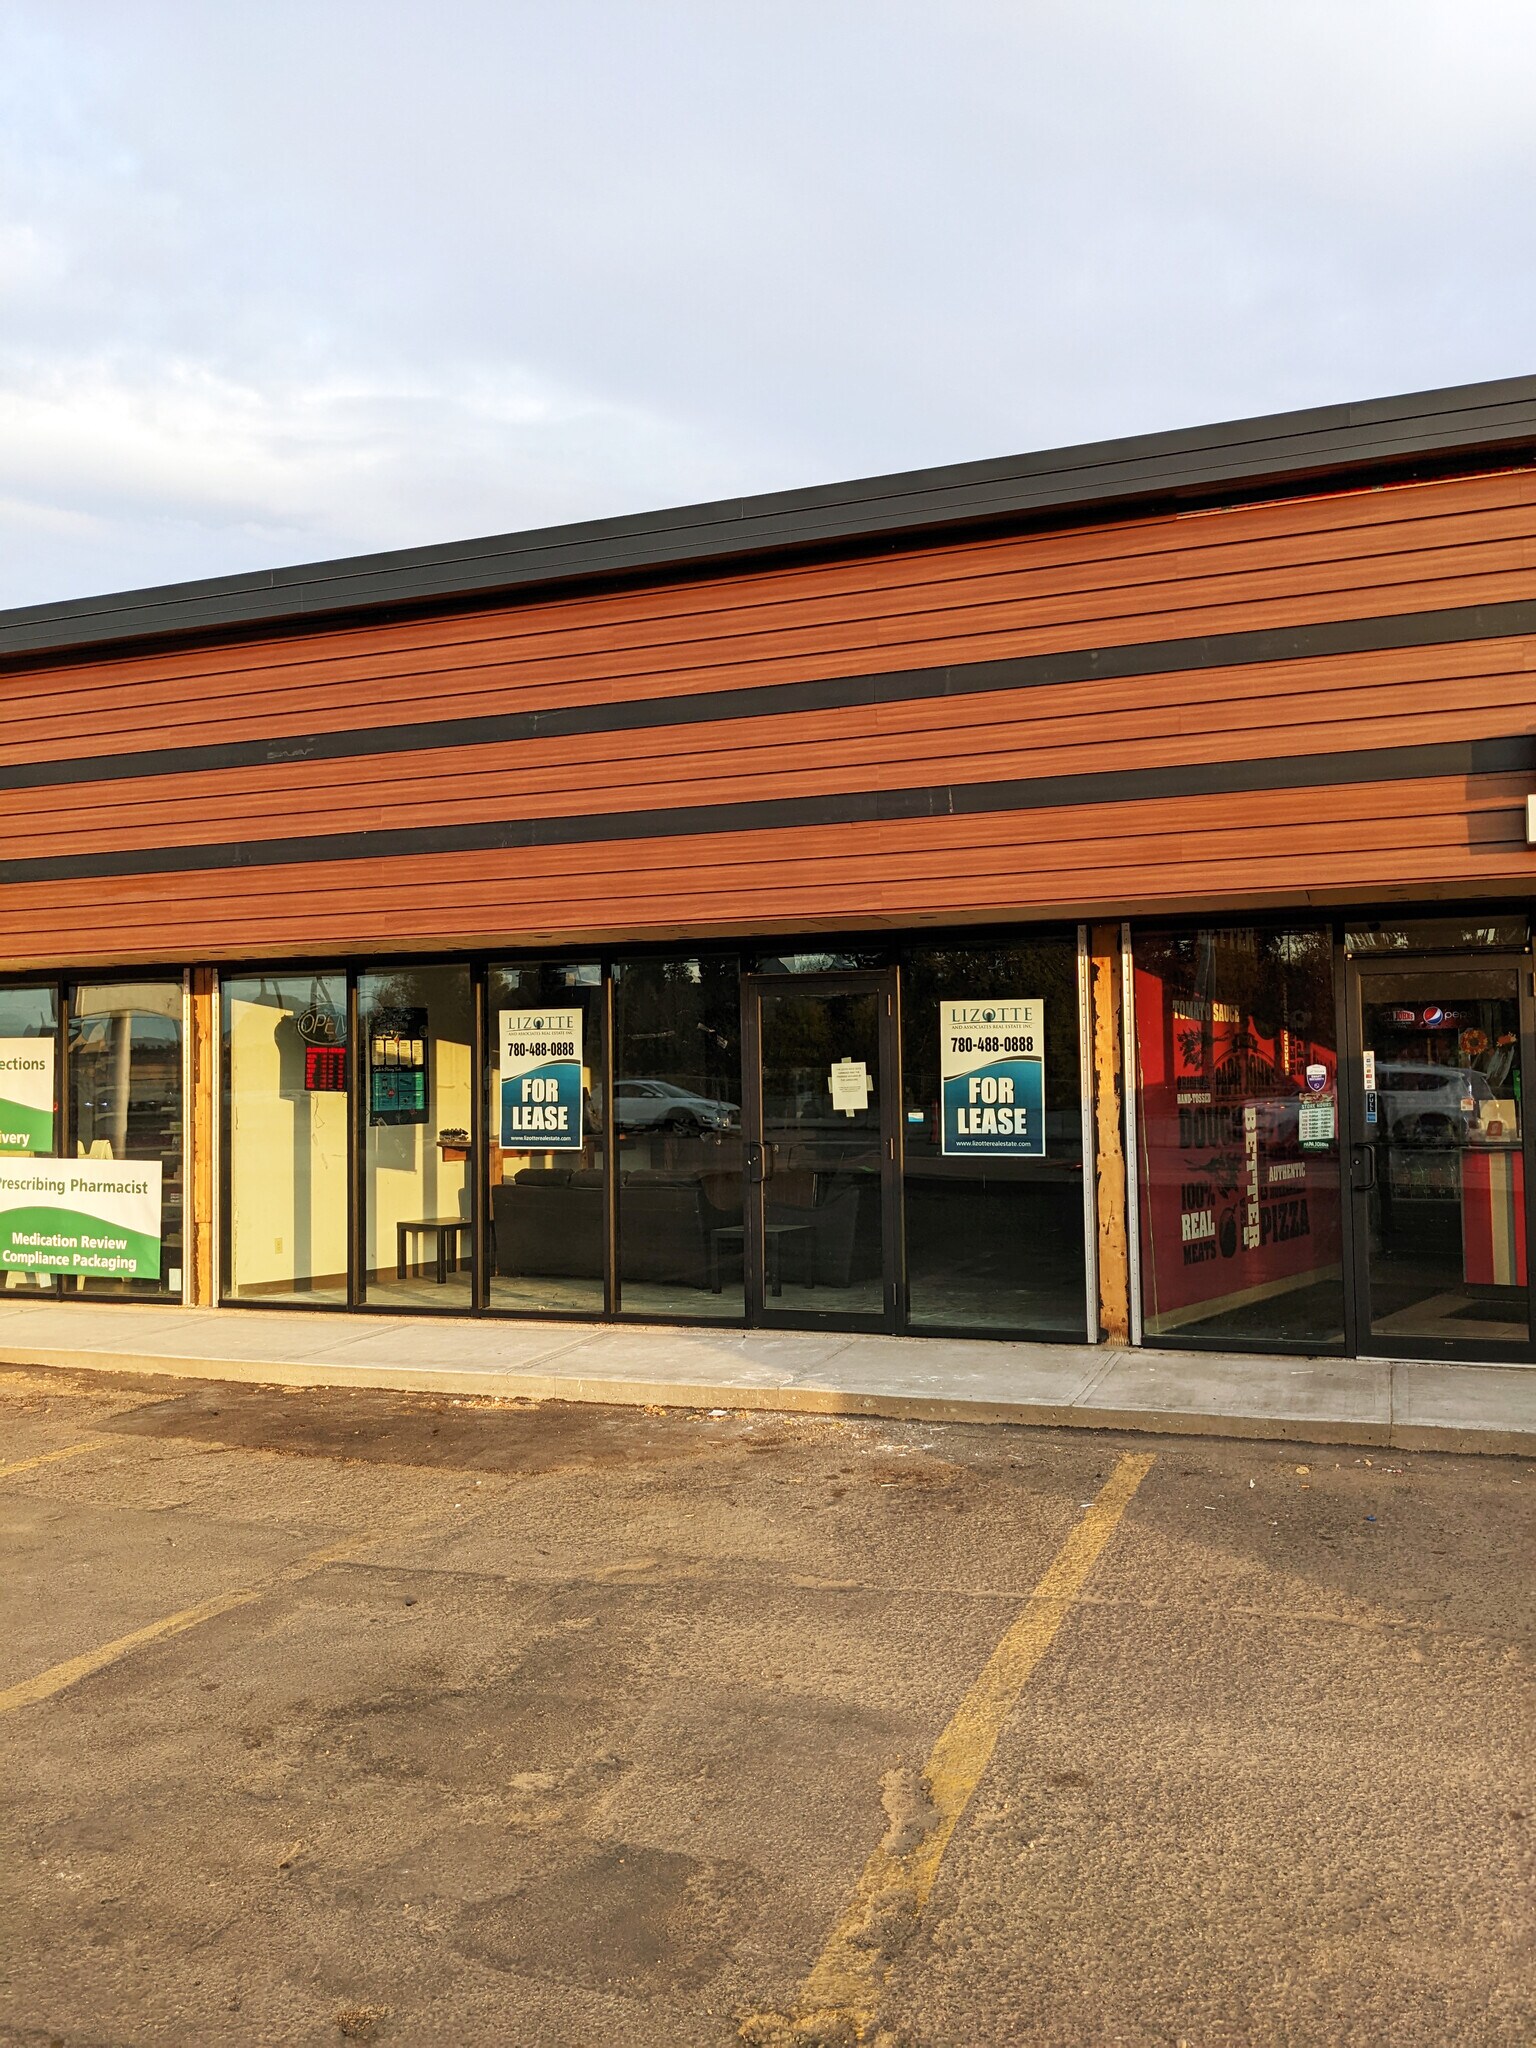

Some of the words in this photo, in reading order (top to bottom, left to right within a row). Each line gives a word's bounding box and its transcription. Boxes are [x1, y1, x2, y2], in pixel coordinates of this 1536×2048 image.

[508, 1015, 574, 1030] LIZOTTE
[952, 1007, 1033, 1023] LIZOTTE
[1173, 1000, 1211, 1023] TOMATO
[1213, 1002, 1240, 1023] SAUCE
[1444, 1011, 1473, 1020] peps
[301, 1013, 347, 1035] OPEN
[508, 1042, 574, 1057] 780-488-0888
[951, 1036, 1033, 1053] 780-488-0888
[0, 1057, 45, 1071] ections
[521, 1078, 559, 1103] FOR
[968, 1077, 1014, 1104] FOR
[512, 1105, 568, 1130] LEASE
[957, 1107, 1027, 1135] LEASE
[956, 1140, 1031, 1148] www.lizotterealestate.com
[1244, 1107, 1260, 1249] BETTER
[1268, 1162, 1306, 1182] AUTHENTIC
[0, 1177, 66, 1195] rescribing
[70, 1178, 148, 1194] Pharmacist
[1181, 1210, 1216, 1242] REAL
[1261, 1199, 1311, 1247] PIZZA
[12, 1232, 78, 1248] Medication
[81, 1235, 127, 1250] Review
[2, 1250, 70, 1266] Compliance
[73, 1253, 137, 1272] Packaging
[1183, 1240, 1217, 1266] MEATS
